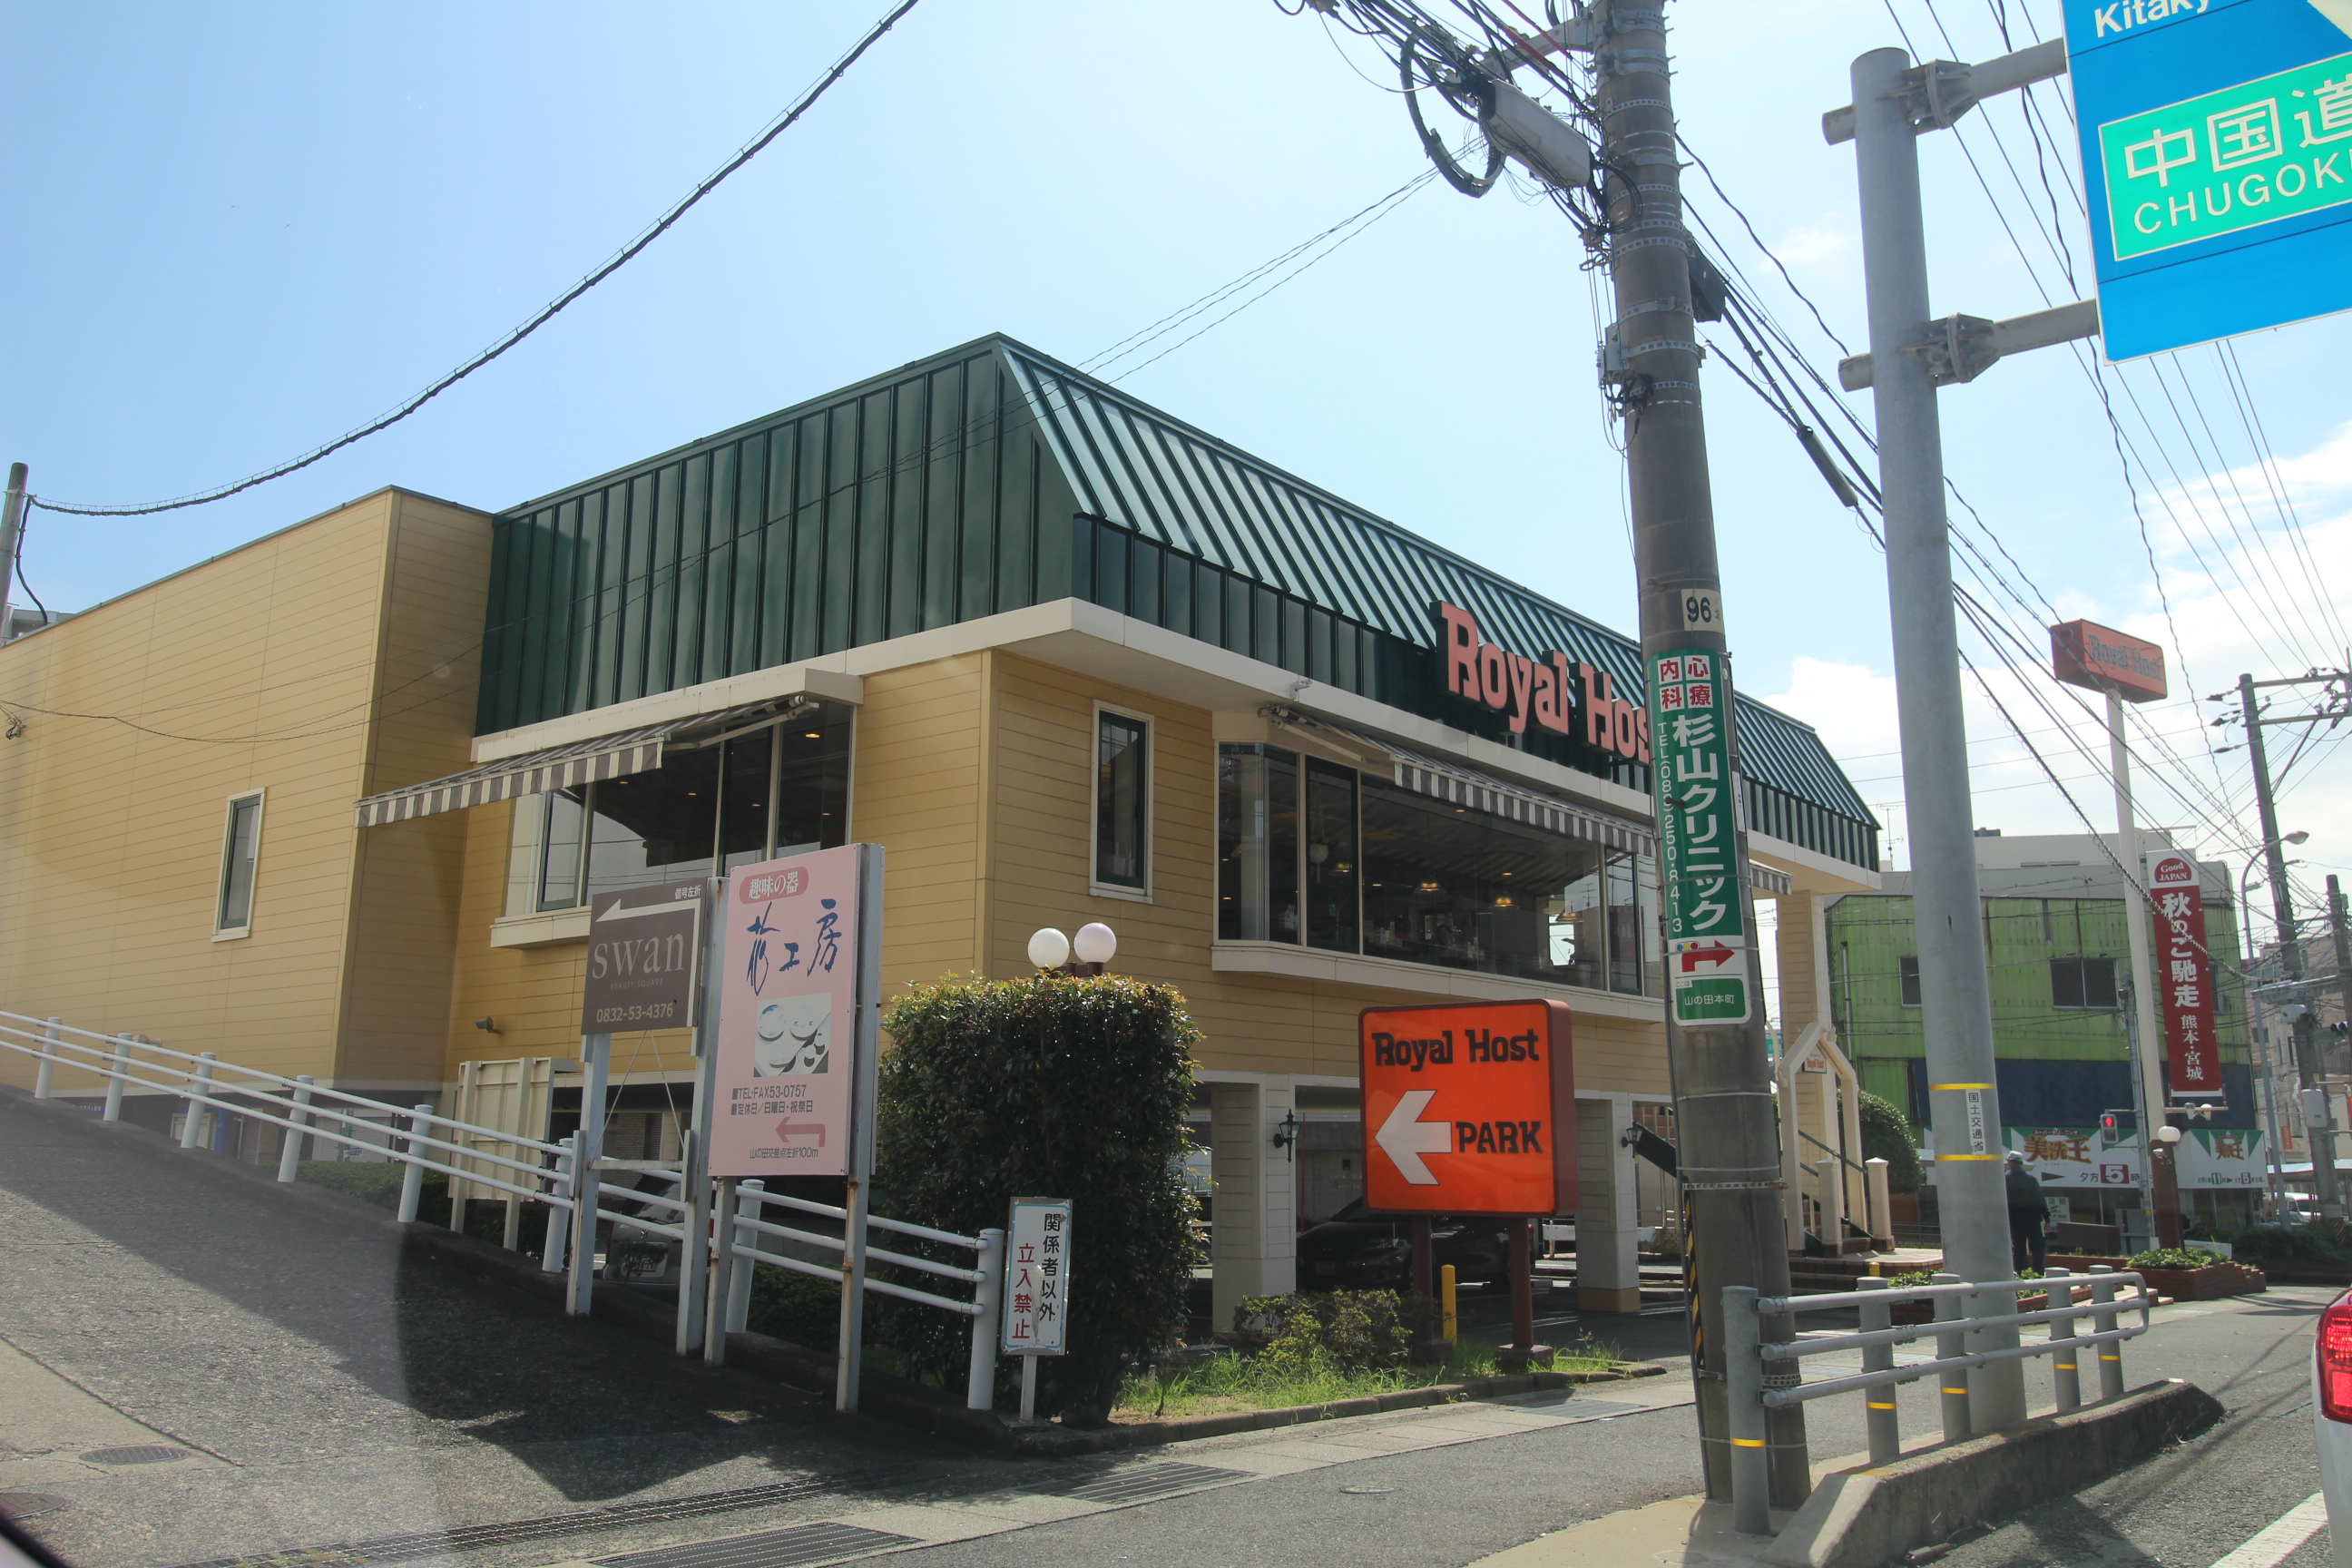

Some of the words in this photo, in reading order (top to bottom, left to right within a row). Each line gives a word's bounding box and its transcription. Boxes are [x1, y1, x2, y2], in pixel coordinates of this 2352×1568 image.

[2134, 148, 2352, 234] CHUGOK
[1686, 596, 1711, 623] 96
[2088, 633, 2129, 671] Royal
[2130, 646, 2163, 682] Host
[1431, 600, 1569, 735] Royal
[1577, 662, 1650, 765] Hos
[1660, 660, 1682, 710] 内科
[1687, 657, 1711, 706] 心療
[1671, 713, 1727, 931] 杉山クリニック
[749, 871, 799, 900] 趣味の器
[2159, 872, 2188, 882] JAPAN
[2160, 861, 2185, 873] Good
[674, 884, 701, 900] 信号左折
[592, 933, 685, 979] swan
[2161, 892, 2200, 1008] 秋のご馳走
[610, 982, 635, 991] BEAUTY
[637, 978, 663, 988] SQUARE
[1684, 995, 1735, 1006] 山の田本町
[596, 1003, 673, 1024] 0832-53-4376
[1371, 1030, 1454, 1073] Royal
[1465, 1028, 1541, 1063] Host
[2180, 1014, 2203, 1081] 熊本・宮城
[1455, 1121, 1544, 1154] PARK
[1968, 1092, 1984, 1152] 国土交通省
[750, 1147, 818, 1159] 山の田交差点左折100m
[1039, 1213, 1061, 1321] 関係者以外
[1012, 1242, 1035, 1339] 立入禁止
